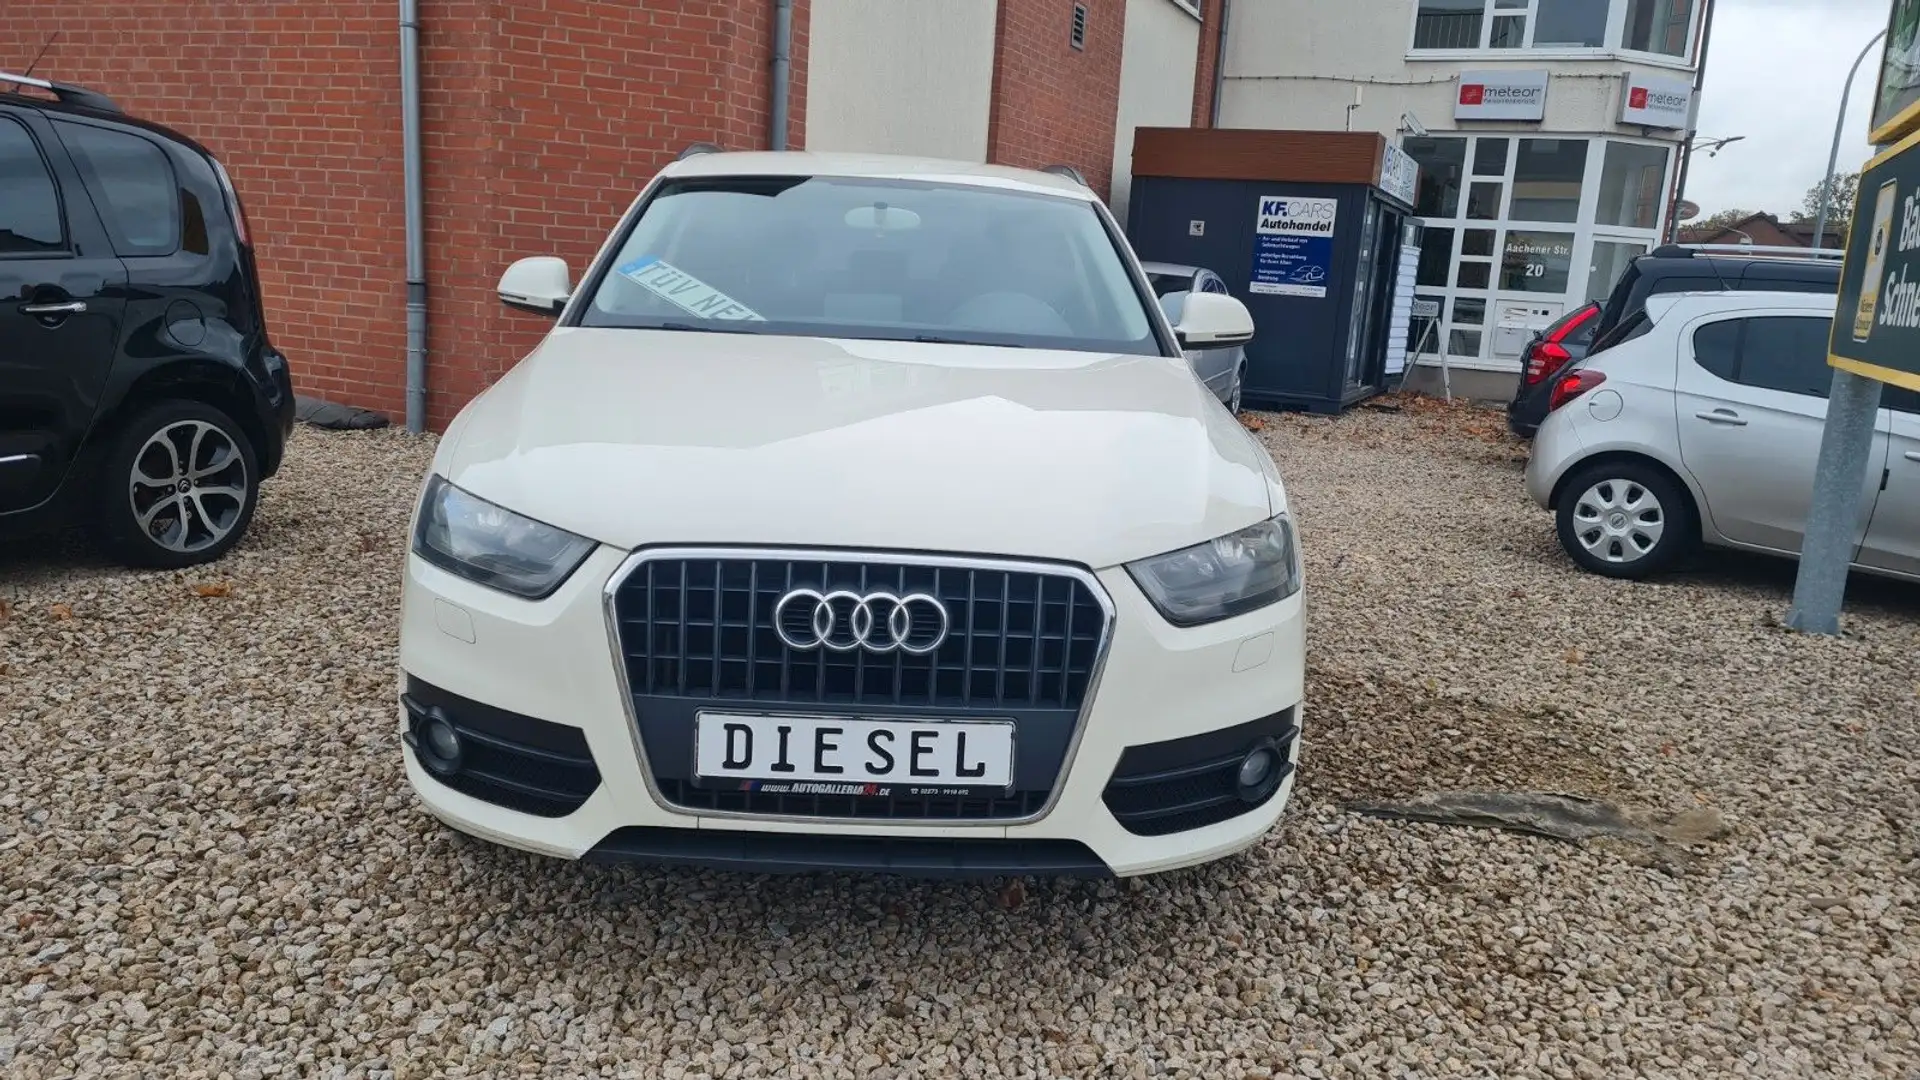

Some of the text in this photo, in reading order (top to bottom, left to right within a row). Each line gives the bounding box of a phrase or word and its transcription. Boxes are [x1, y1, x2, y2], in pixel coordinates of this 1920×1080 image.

[1484, 86, 1539, 97] meteor
[1647, 93, 1685, 106] meteor
[1260, 218, 1331, 231] Autohandel
[1898, 186, 1920, 252] Bä
[1506, 243, 1569, 256] Aachener Str.
[1526, 263, 1545, 277] 20
[637, 264, 700, 295] TÜV
[1879, 263, 1920, 328] Schne
[722, 722, 986, 778] DIESEL
